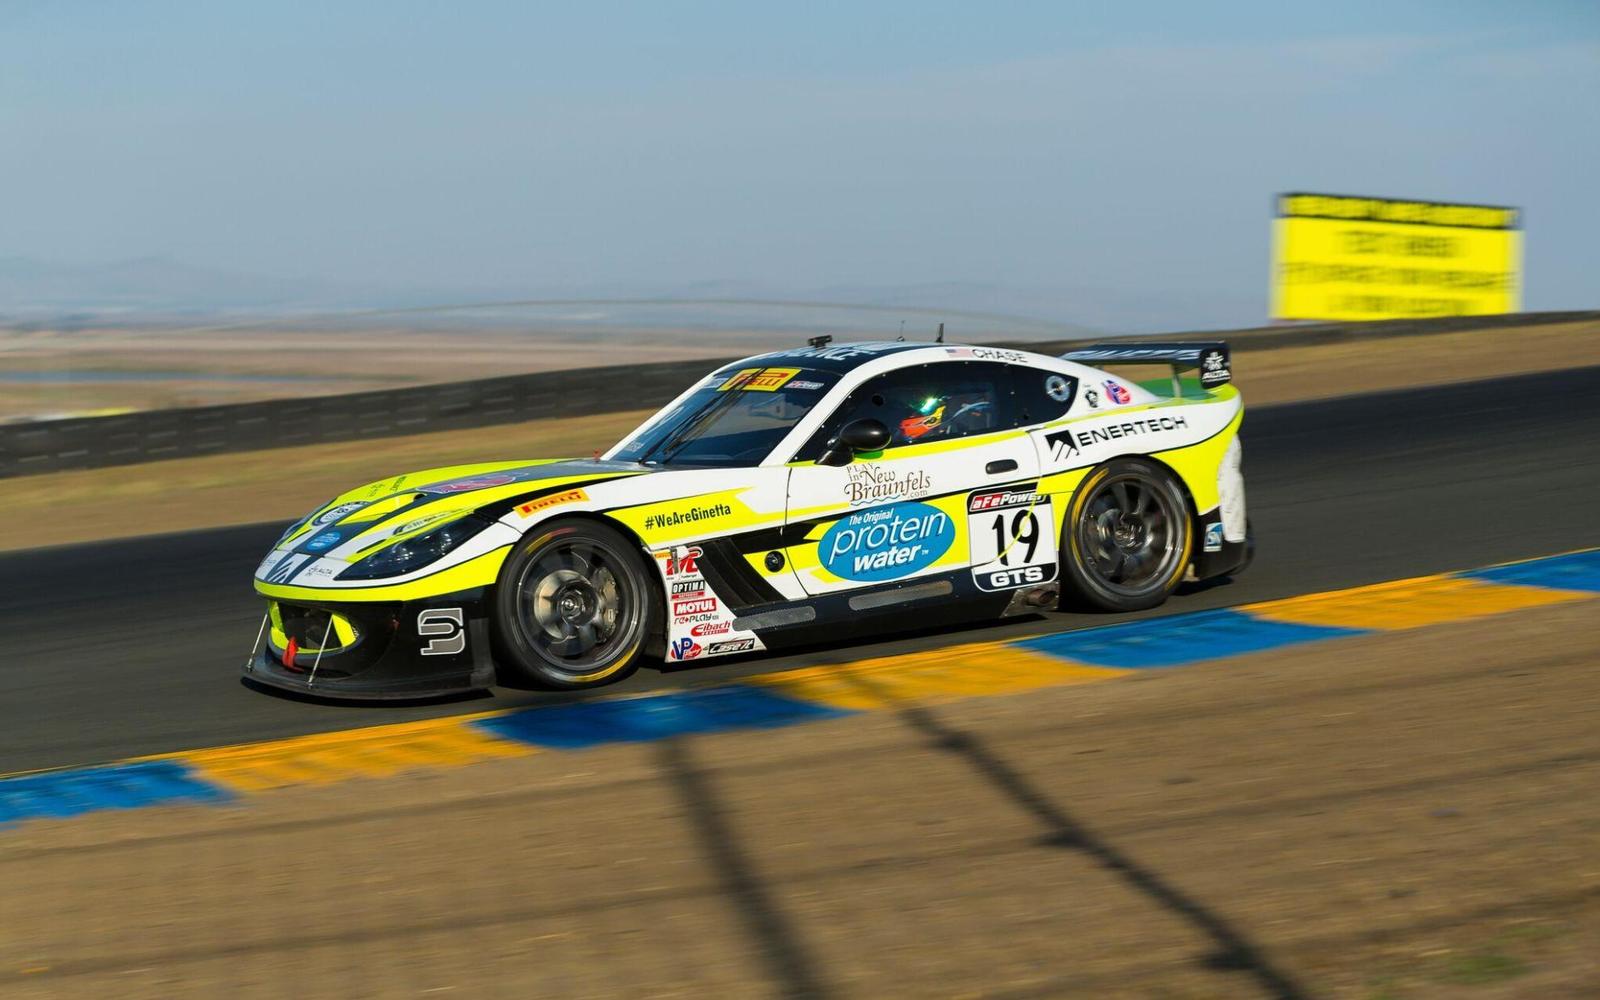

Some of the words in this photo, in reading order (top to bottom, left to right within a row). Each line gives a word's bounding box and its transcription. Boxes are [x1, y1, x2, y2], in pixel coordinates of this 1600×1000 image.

[972, 348, 1028, 363] CHASE
[1076, 416, 1189, 447] ENERTECH
[844, 470, 931, 501] Braunfels
[859, 466, 896, 486] New
[644, 504, 732, 530] #WeAreGinetta
[849, 515, 863, 526] The
[863, 508, 895, 524] Original
[828, 512, 946, 566] protein
[992, 509, 1039, 567] 19
[853, 545, 922, 574] water
[672, 581, 704, 593] OPTIMA
[989, 566, 1044, 588] GTS
[676, 600, 715, 614] MOTUL
[690, 620, 731, 637] Eibach
